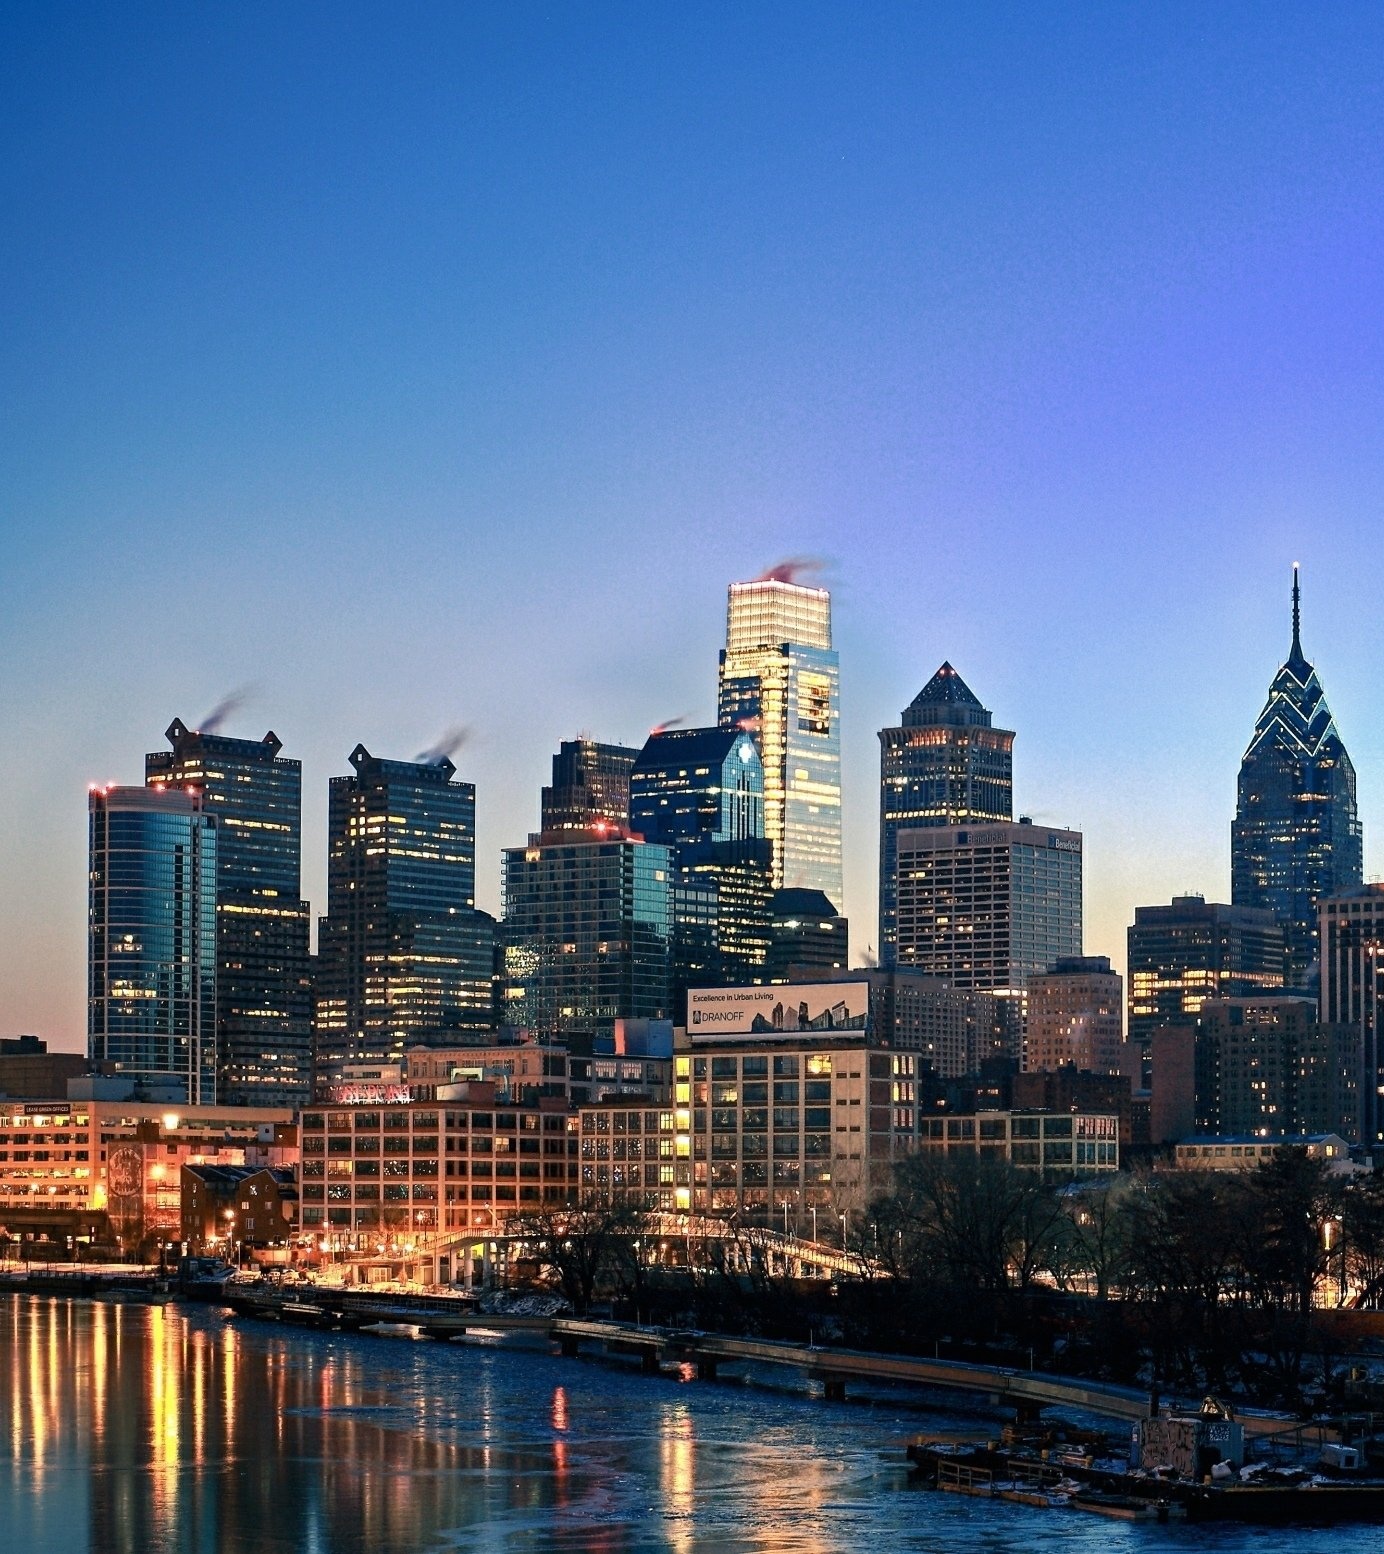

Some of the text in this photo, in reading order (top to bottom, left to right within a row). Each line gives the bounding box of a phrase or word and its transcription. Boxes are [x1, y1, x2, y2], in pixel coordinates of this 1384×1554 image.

[1055, 838, 1081, 851] Beneficial
[692, 994, 726, 1002] Excellence
[733, 993, 753, 1001] Urban
[754, 992, 774, 1001] Living
[702, 1011, 744, 1022] DRANOFF
